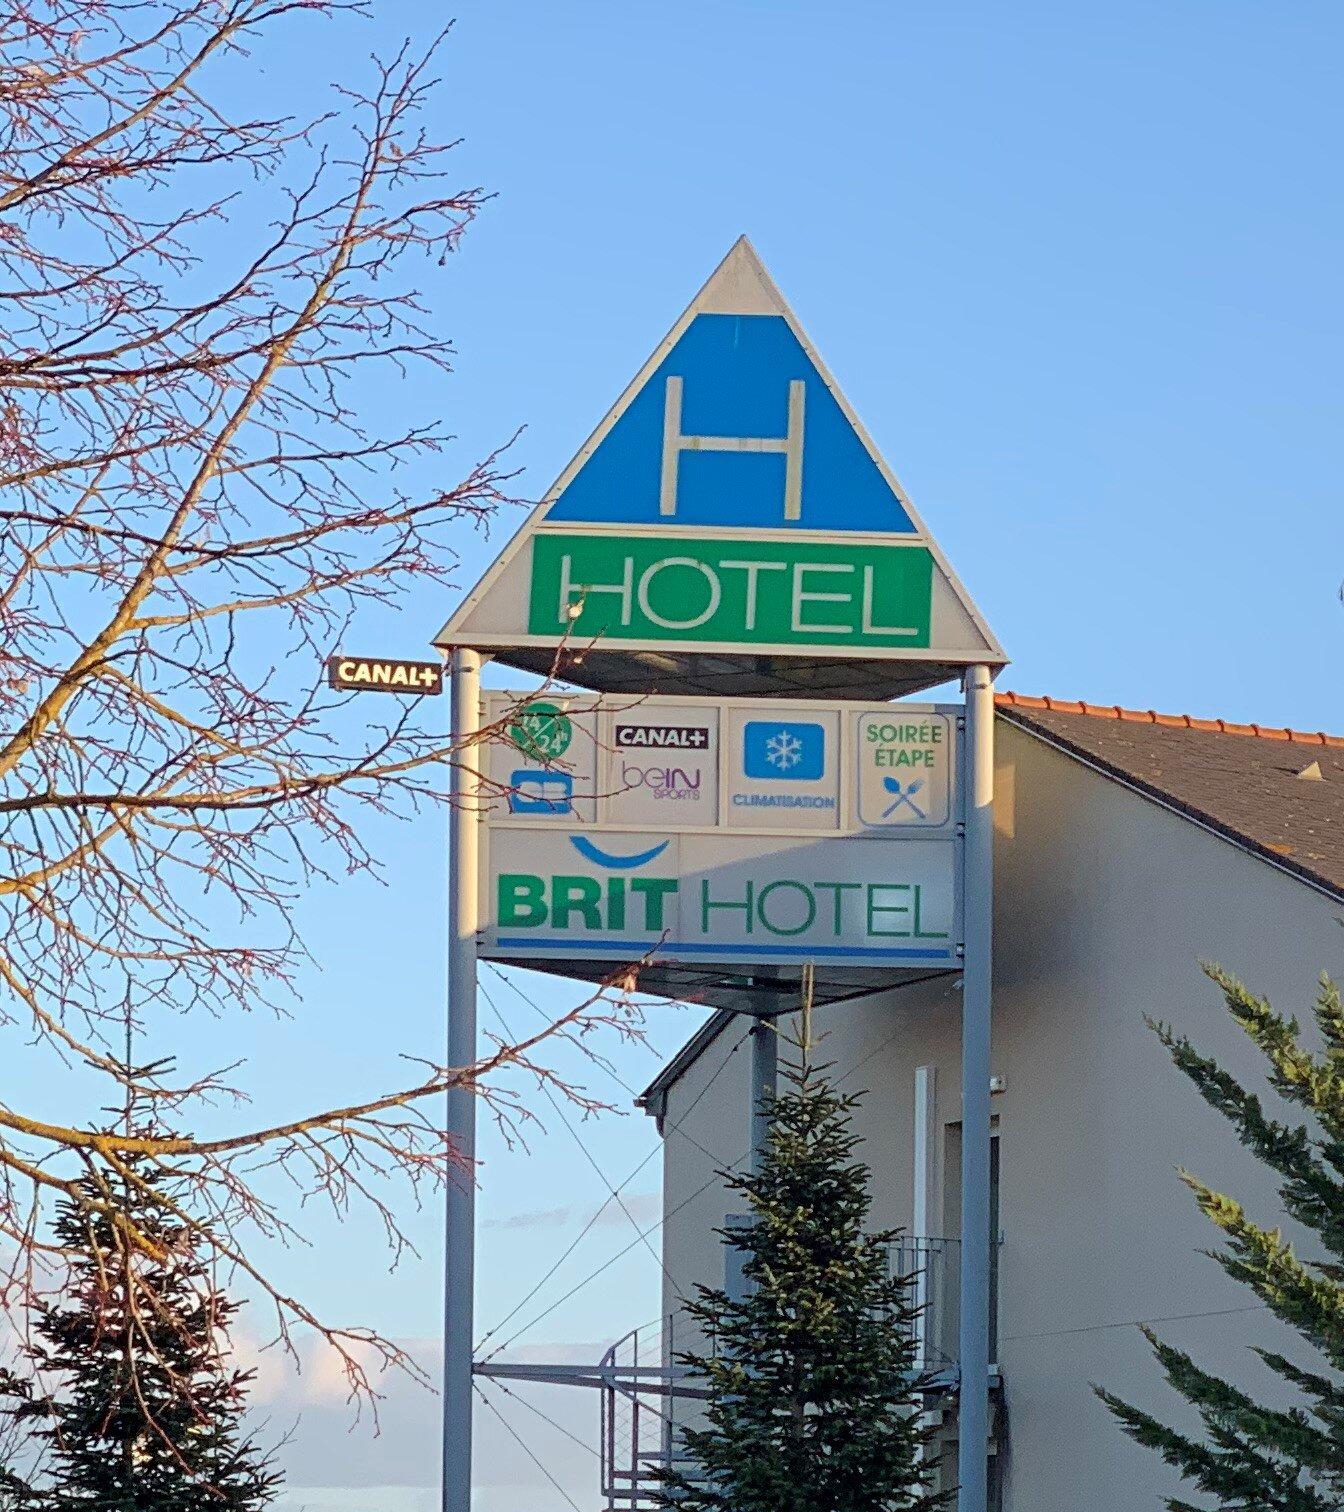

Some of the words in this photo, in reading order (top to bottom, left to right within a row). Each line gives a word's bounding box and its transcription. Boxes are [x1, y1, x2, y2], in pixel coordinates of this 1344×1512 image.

[660, 376, 805, 520] H
[559, 555, 918, 635] HOTEL
[338, 661, 438, 687] CANAL+
[619, 728, 705, 747] CANAL+
[866, 720, 942, 744] SOIRÉE
[874, 744, 935, 768] ÉTAPE
[622, 760, 700, 790] beIN
[653, 788, 700, 800] SPORTS
[733, 793, 835, 809] CLIMATISATION
[498, 873, 679, 931] BRIT
[702, 879, 948, 938] HOTEL
